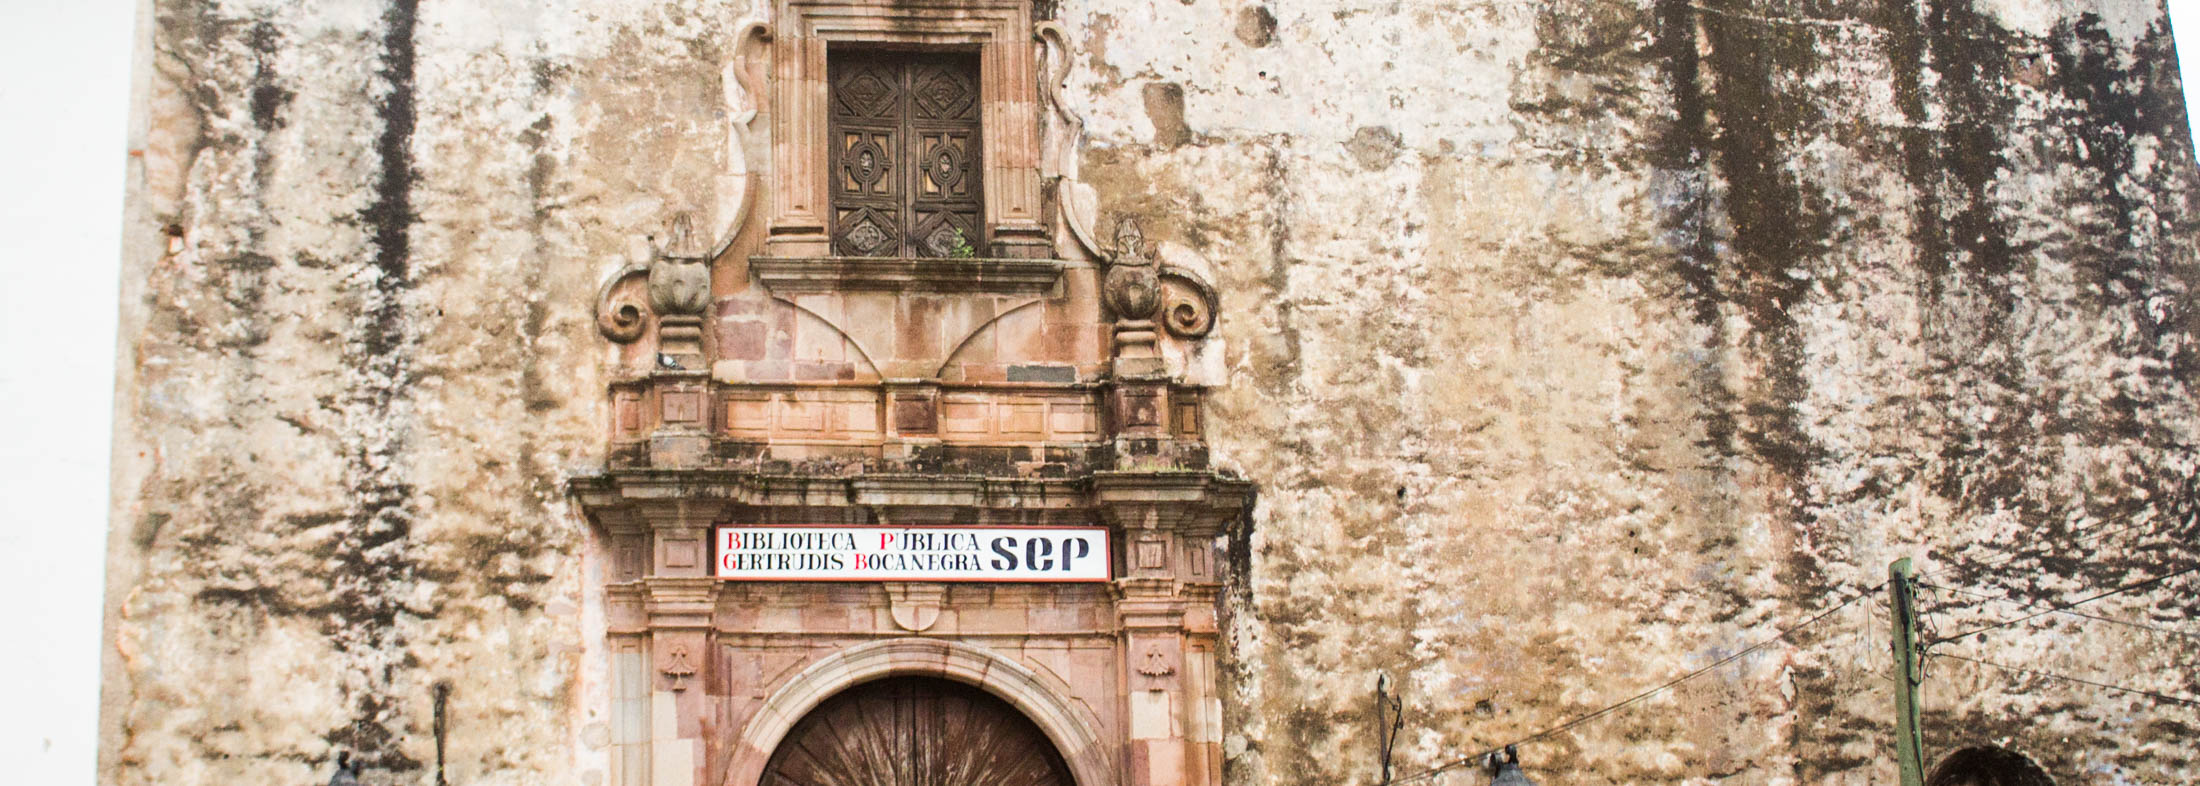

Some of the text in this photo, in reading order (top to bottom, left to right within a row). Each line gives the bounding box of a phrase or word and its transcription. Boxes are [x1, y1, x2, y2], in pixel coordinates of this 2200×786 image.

[727, 528, 982, 551] BIBLIOTECA PÚBLICA
[723, 553, 983, 572] GERTRUDIS BOCANEGRA
